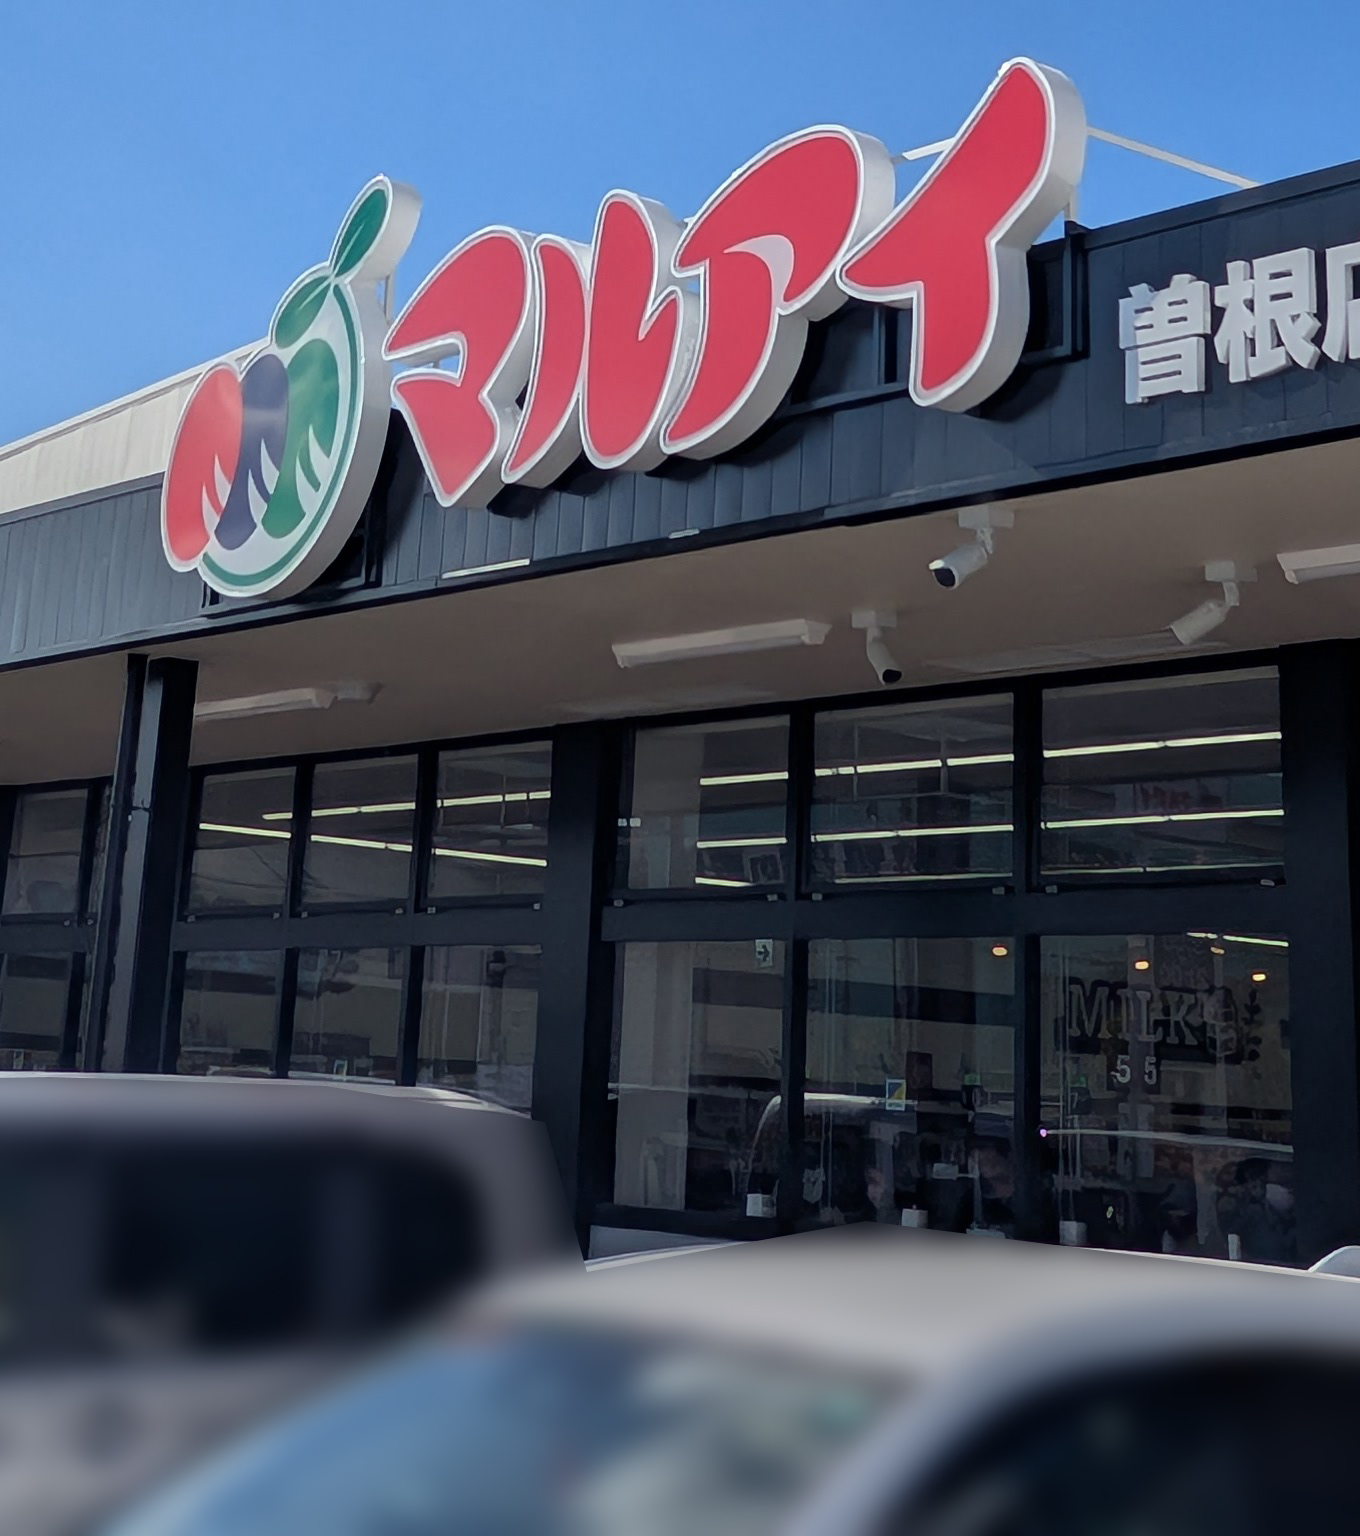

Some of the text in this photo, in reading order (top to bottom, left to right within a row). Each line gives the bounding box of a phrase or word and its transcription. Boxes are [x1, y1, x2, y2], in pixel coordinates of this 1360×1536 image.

[381, 56, 1082, 508] マルアイ
[1068, 983, 1198, 1046] MILK
[1115, 1055, 1131, 1084] 5
[1144, 1056, 1157, 1085] 5
